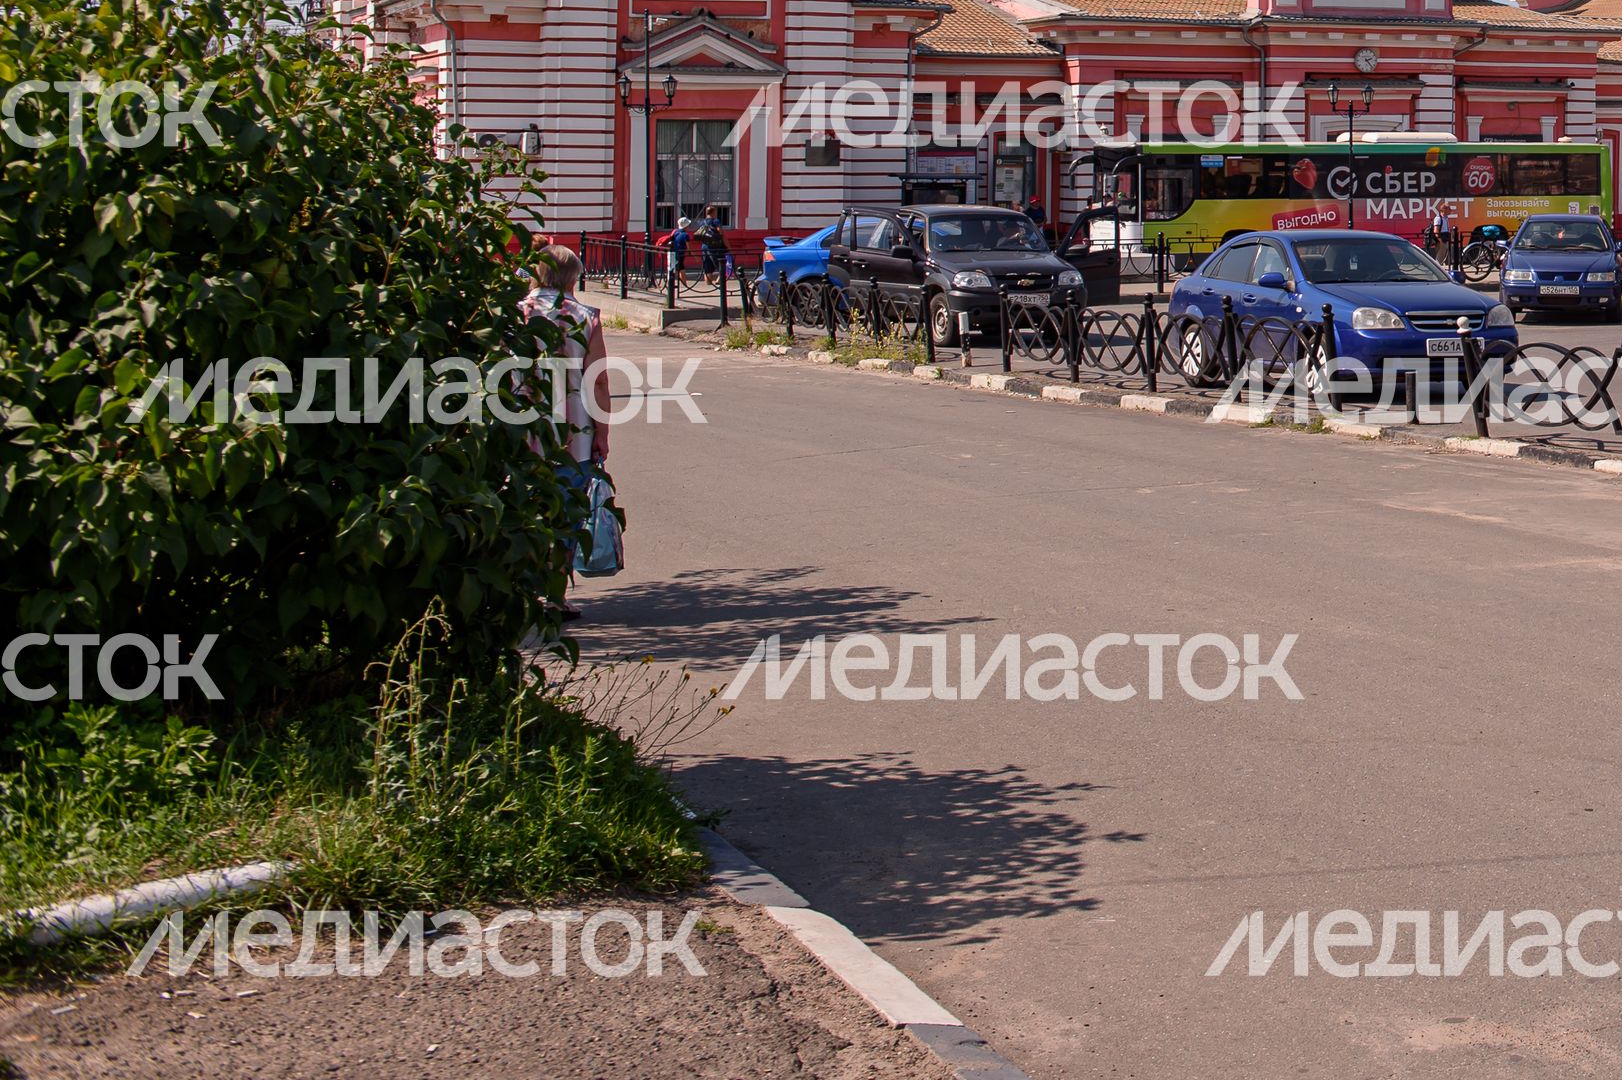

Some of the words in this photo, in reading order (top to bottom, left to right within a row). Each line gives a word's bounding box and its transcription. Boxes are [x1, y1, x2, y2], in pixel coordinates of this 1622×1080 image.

[1365, 171, 1437, 194] СБЕР
[1366, 197, 1475, 220] МАРКЕТ
[1487, 198, 1550, 208] Заказывайте
[1277, 211, 1337, 230] ВЫГОДНО
[1487, 209, 1529, 219] выгодно
[1431, 341, 1463, 352] С661А
